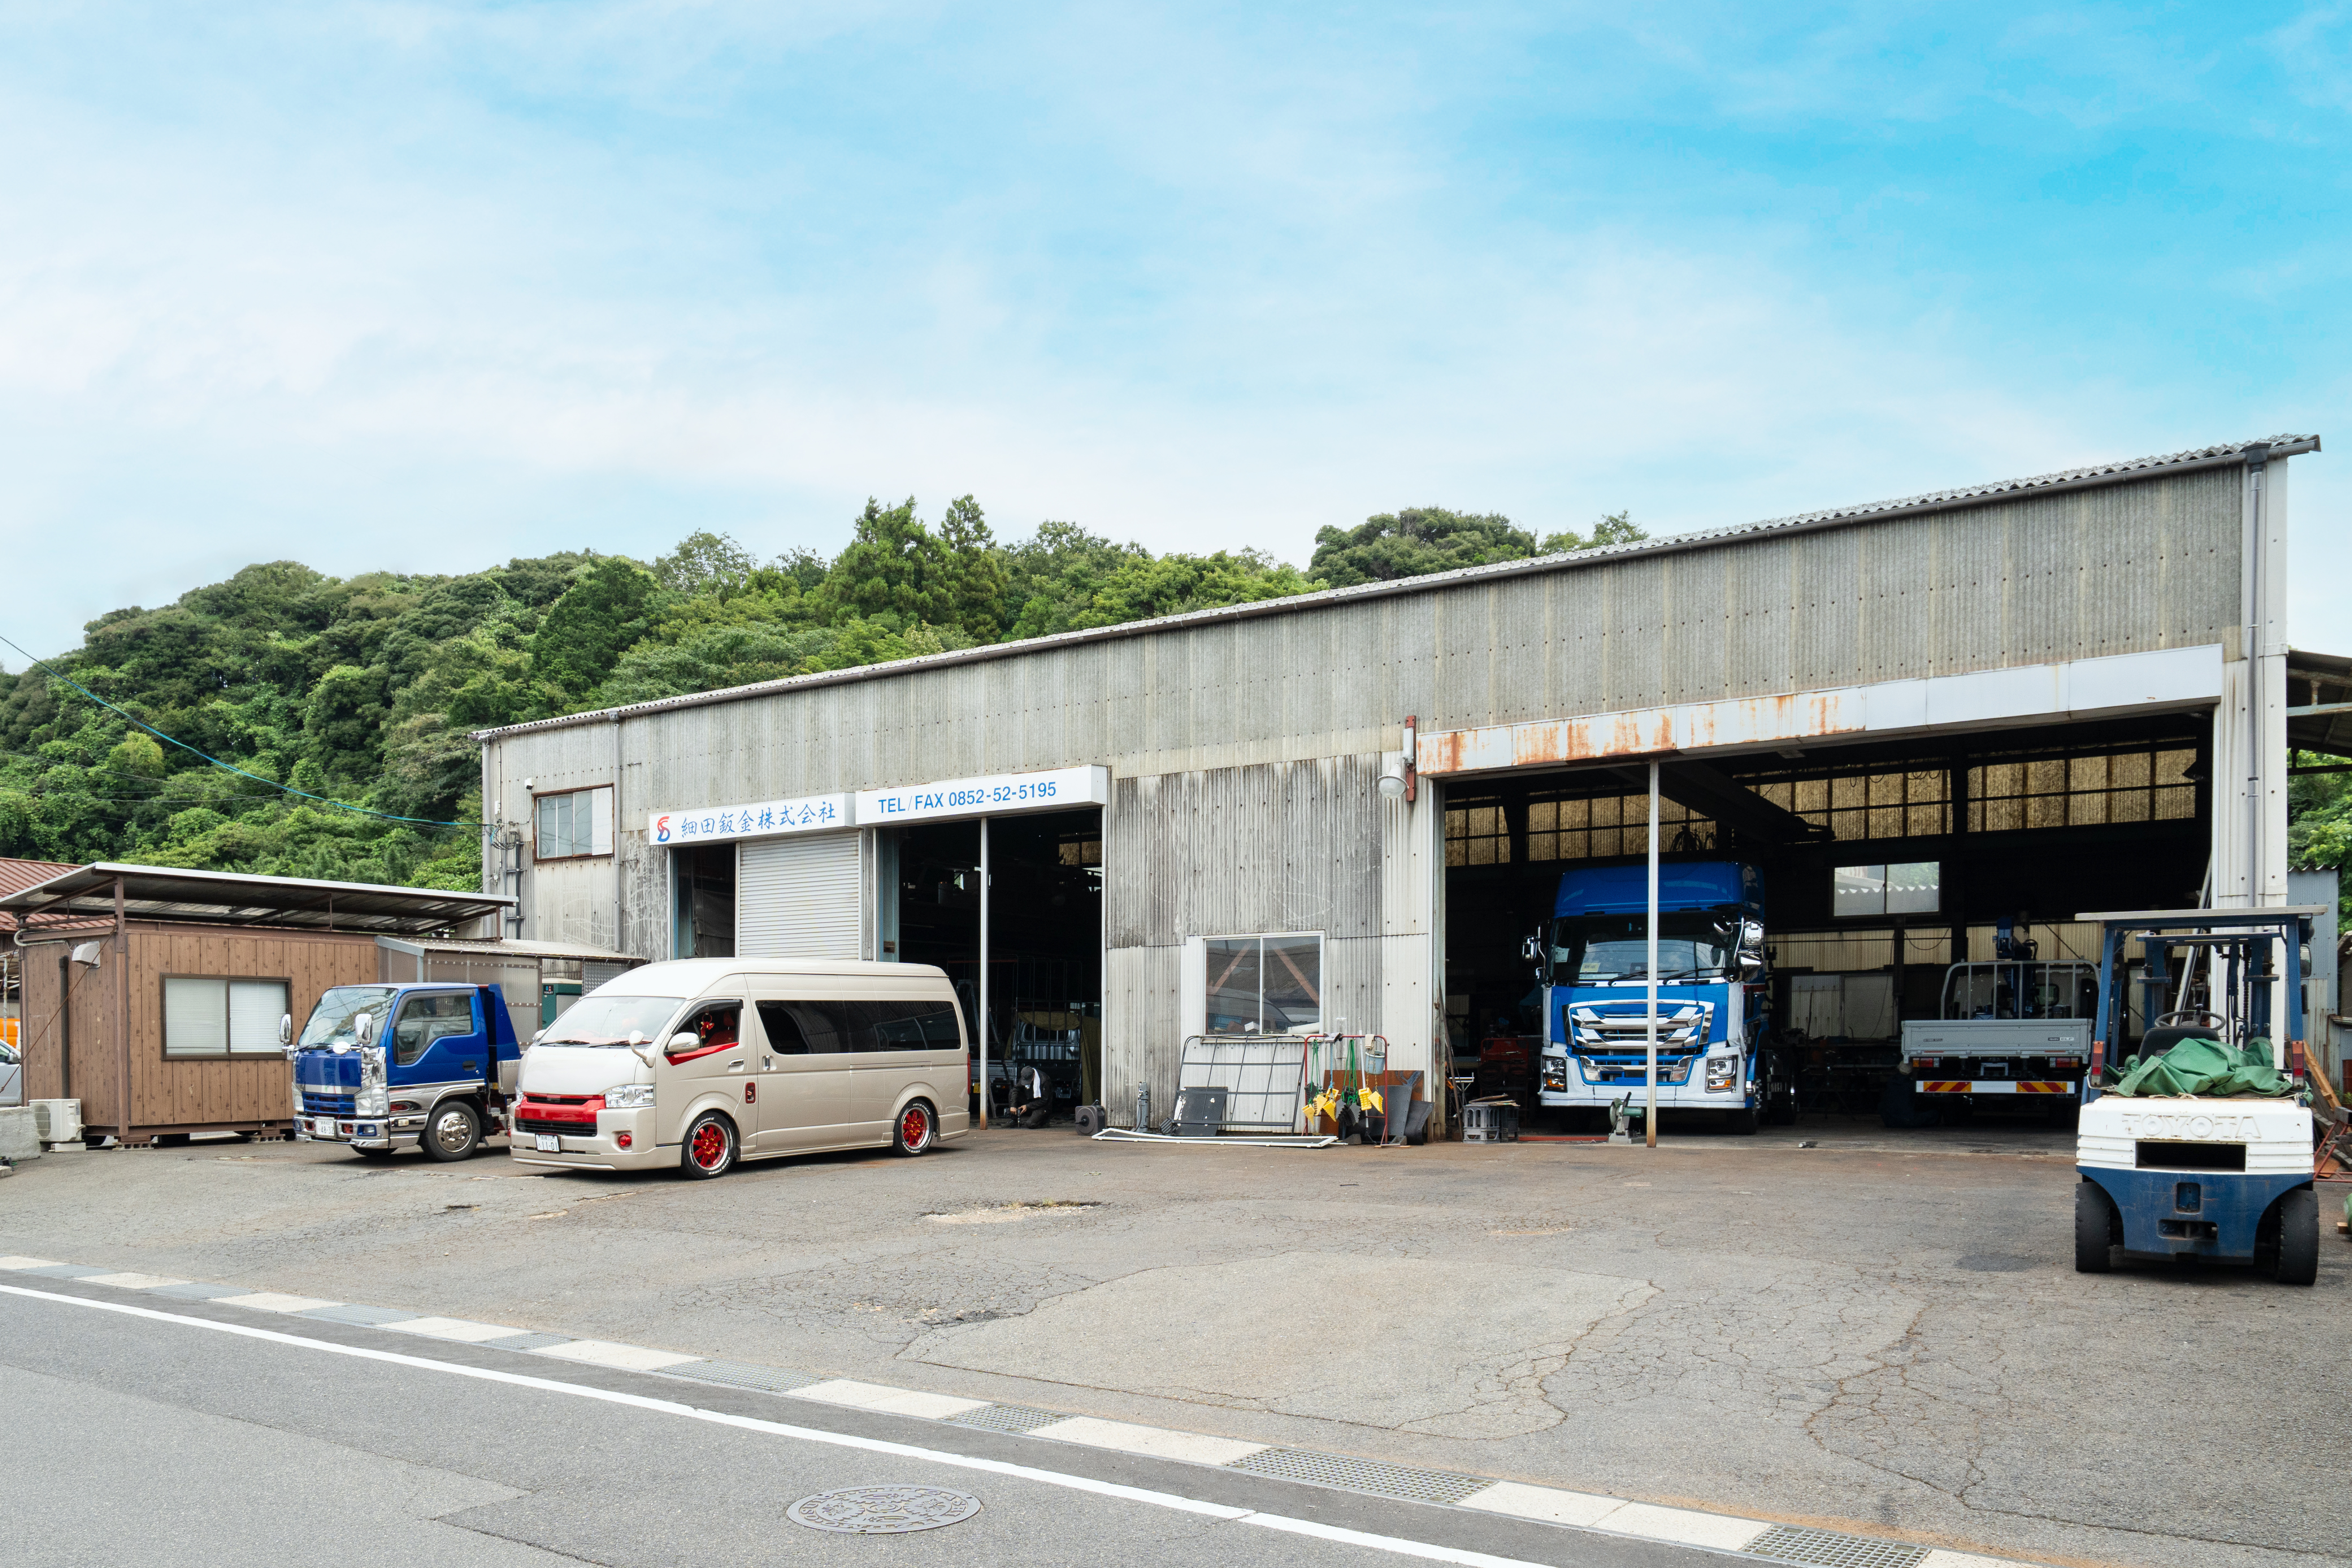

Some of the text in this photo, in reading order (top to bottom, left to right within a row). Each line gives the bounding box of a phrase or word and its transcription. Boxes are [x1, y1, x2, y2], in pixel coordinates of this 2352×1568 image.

[878, 782, 1057, 814] TEL/FAX 0852-52-5195
[681, 801, 836, 838] 細田鈑金株式会社
[922, 1105, 930, 1115] TIRES
[321, 1126, 334, 1134] 48-32
[692, 1122, 701, 1135] TOYO
[2122, 1113, 2262, 1139] TOYOTA
[542, 1141, 558, 1151] 11-01
[722, 1157, 731, 1170] TOYO
